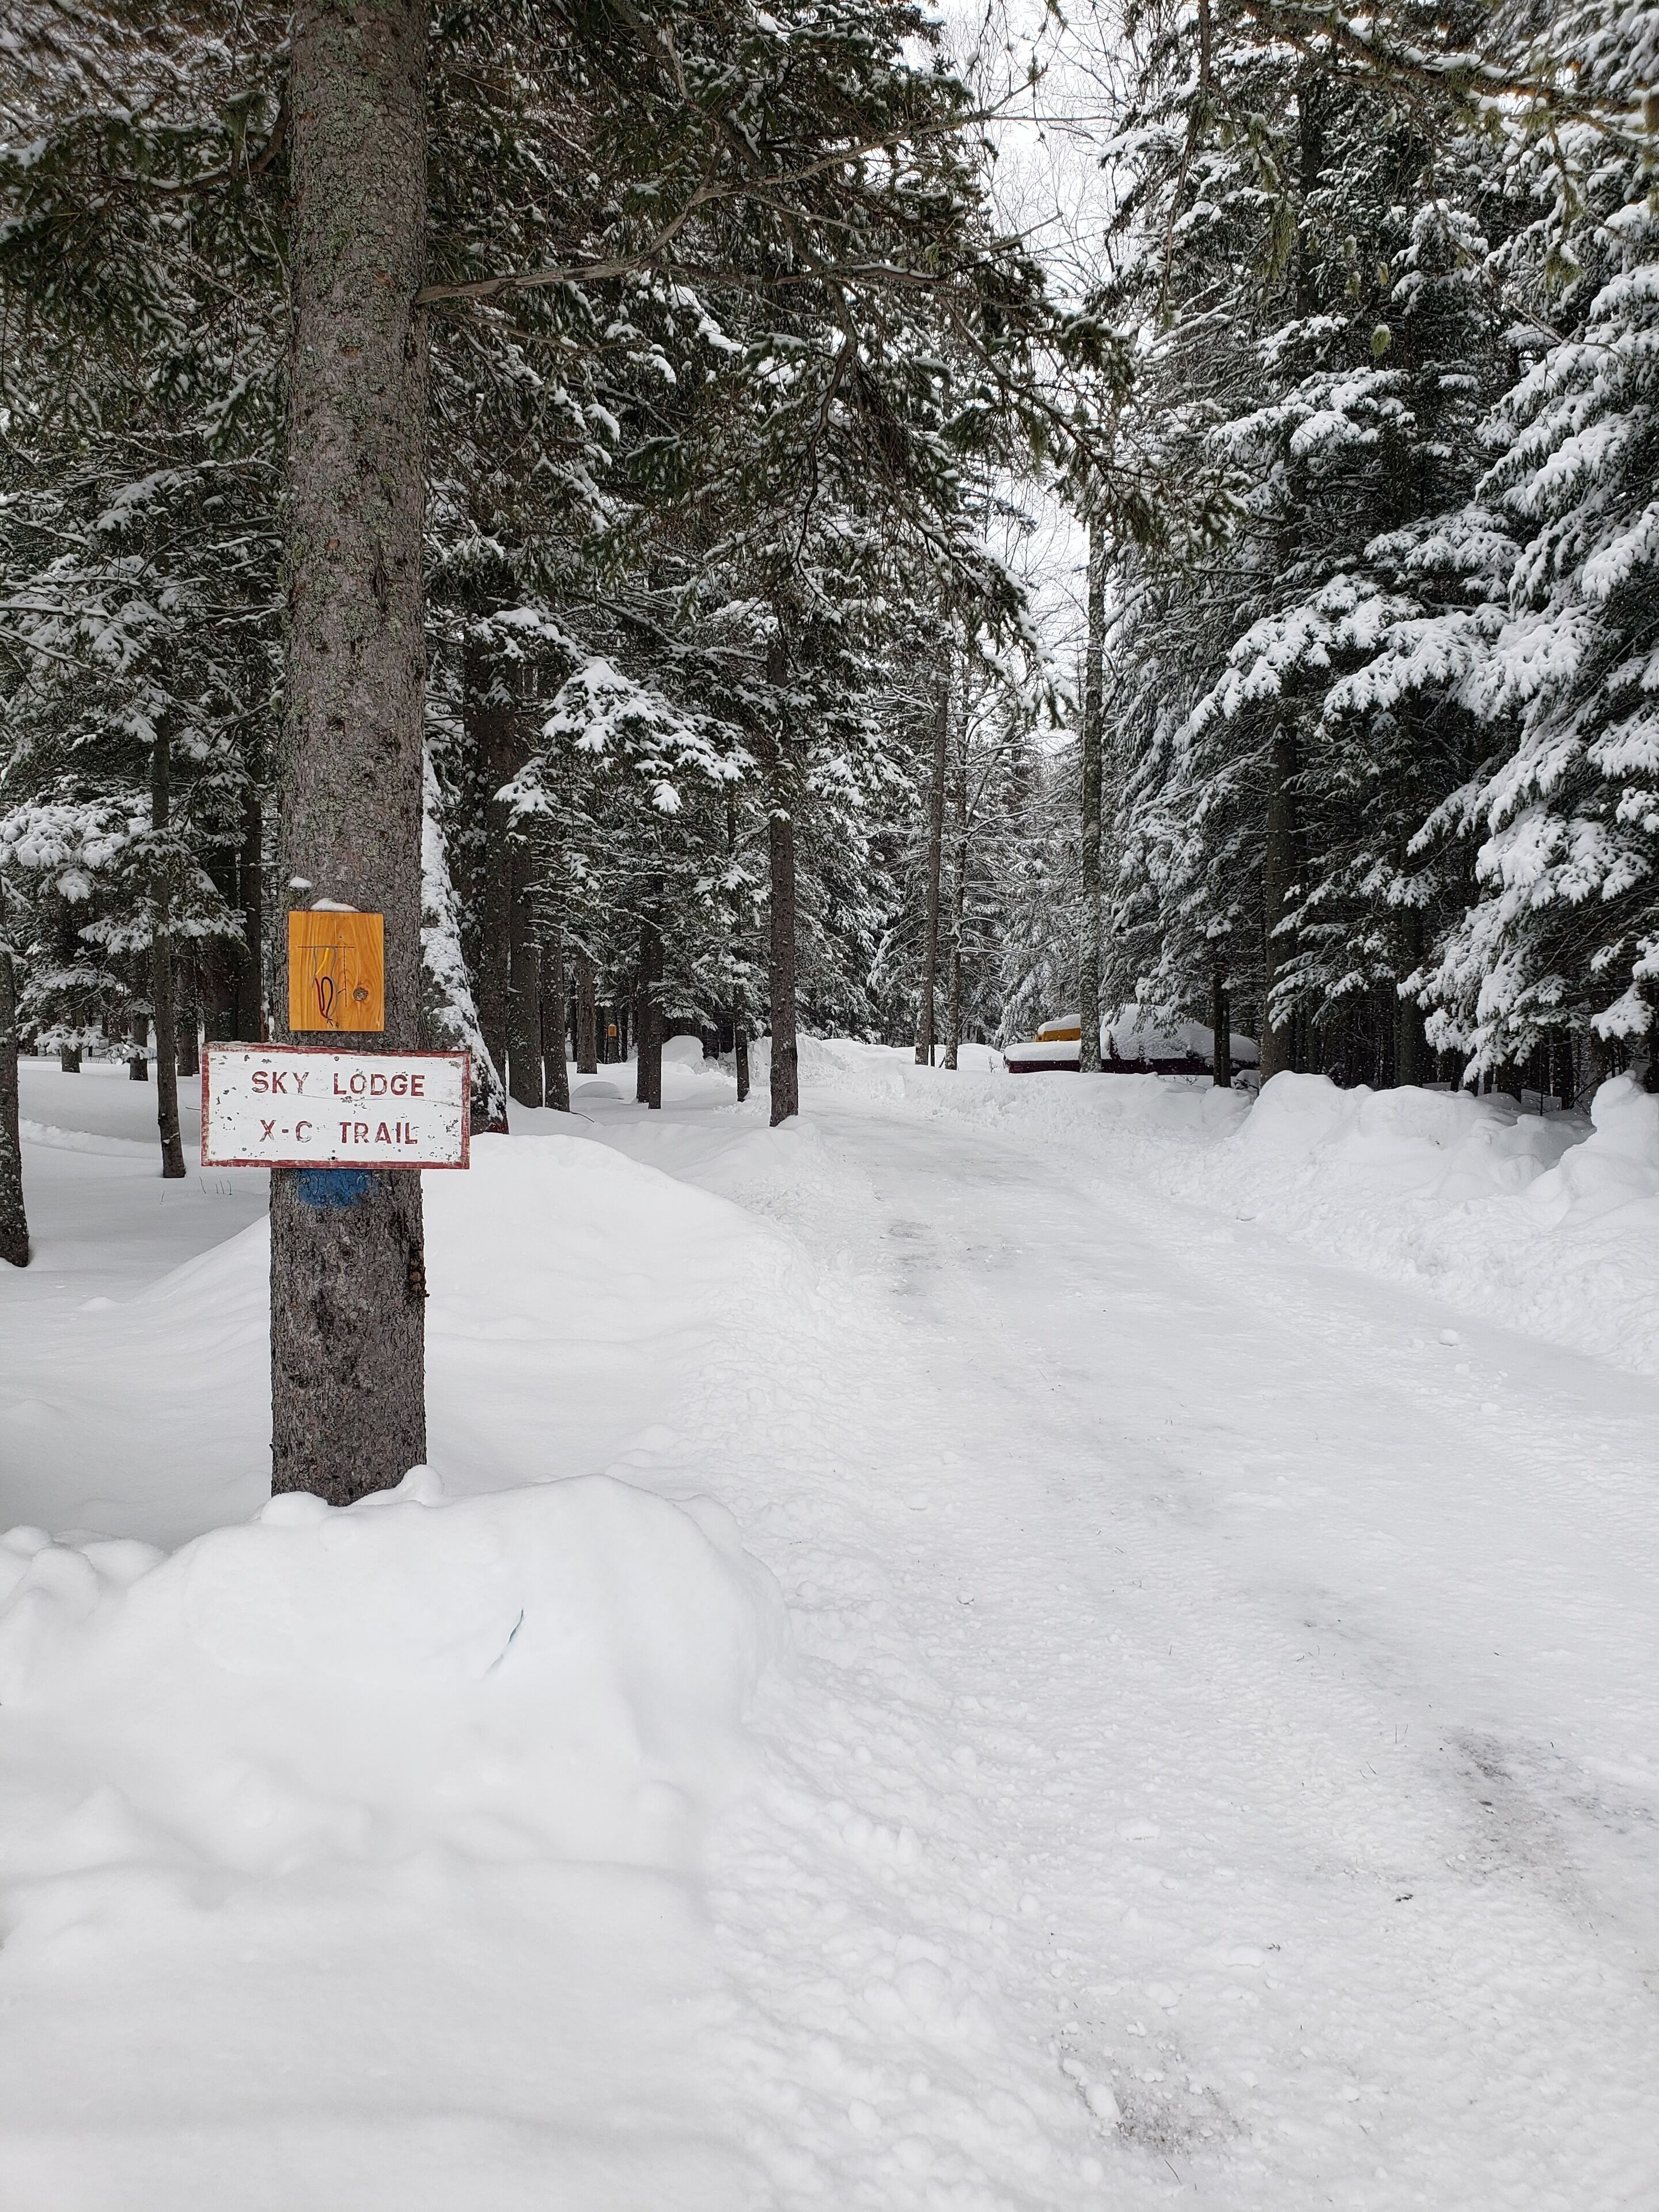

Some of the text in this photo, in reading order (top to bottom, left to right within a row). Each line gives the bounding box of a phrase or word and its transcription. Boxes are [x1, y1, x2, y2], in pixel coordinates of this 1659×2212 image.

[252, 1071, 425, 1096] SKY LODGE
[260, 1120, 418, 1144] X-C TRAIL
